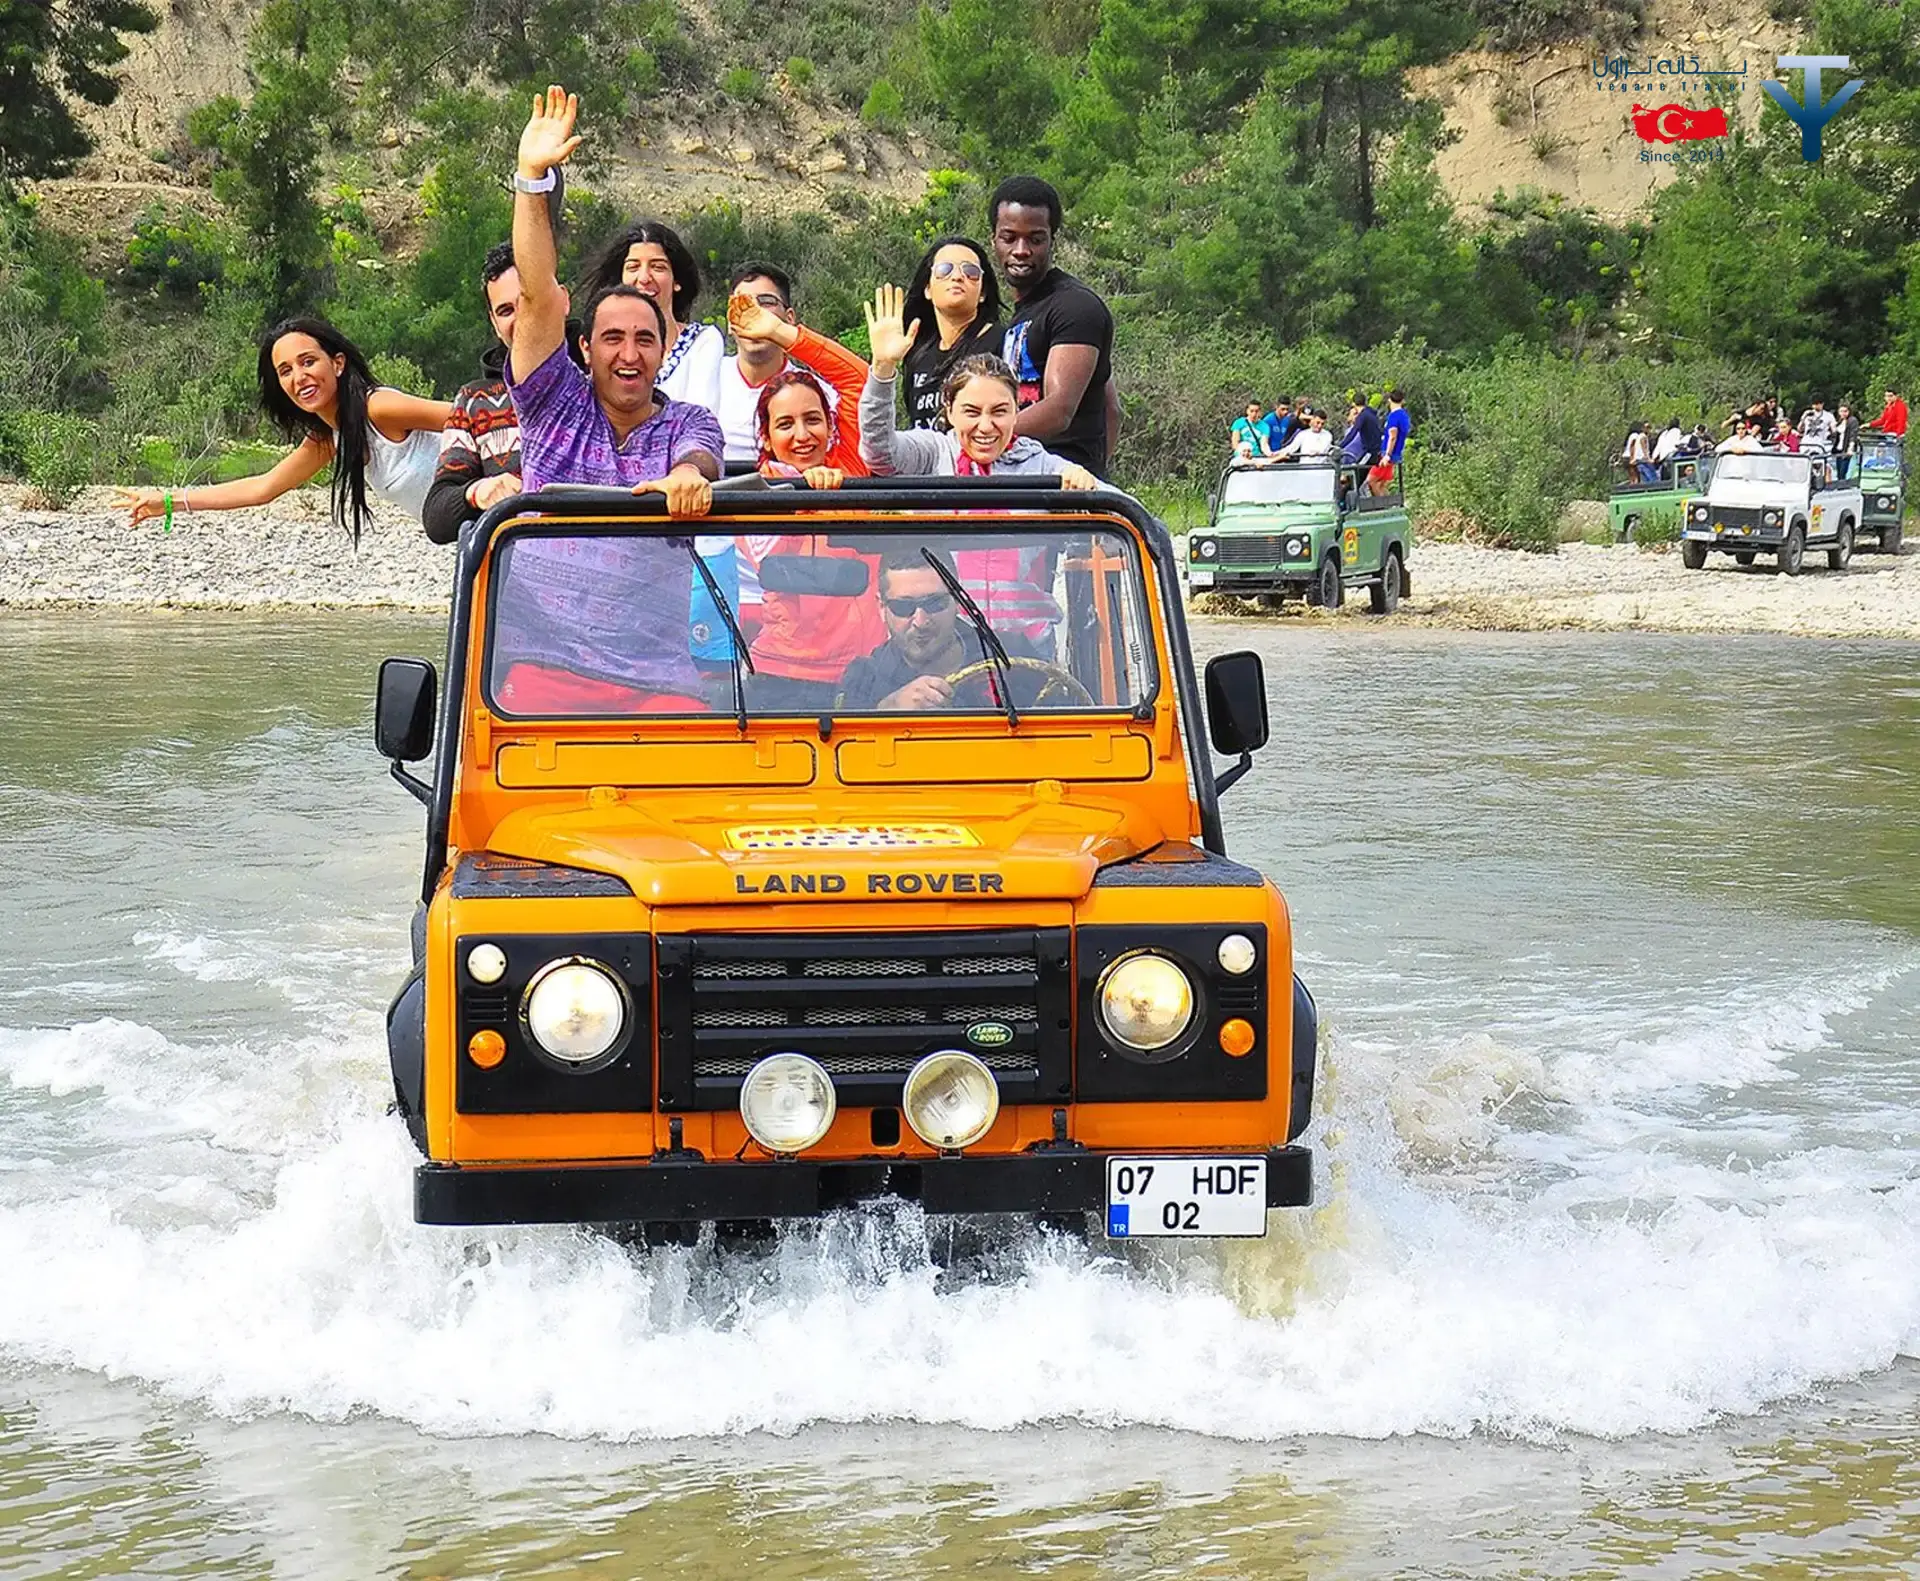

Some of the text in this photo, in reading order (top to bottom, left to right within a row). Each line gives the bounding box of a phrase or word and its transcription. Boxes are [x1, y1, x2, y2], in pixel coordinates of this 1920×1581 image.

[735, 872, 1004, 894] LAND ROVER
[1117, 1165, 1260, 1195] 07 HDF
[1112, 1223, 1127, 1233] TR
[1162, 1201, 1200, 1230] 02
